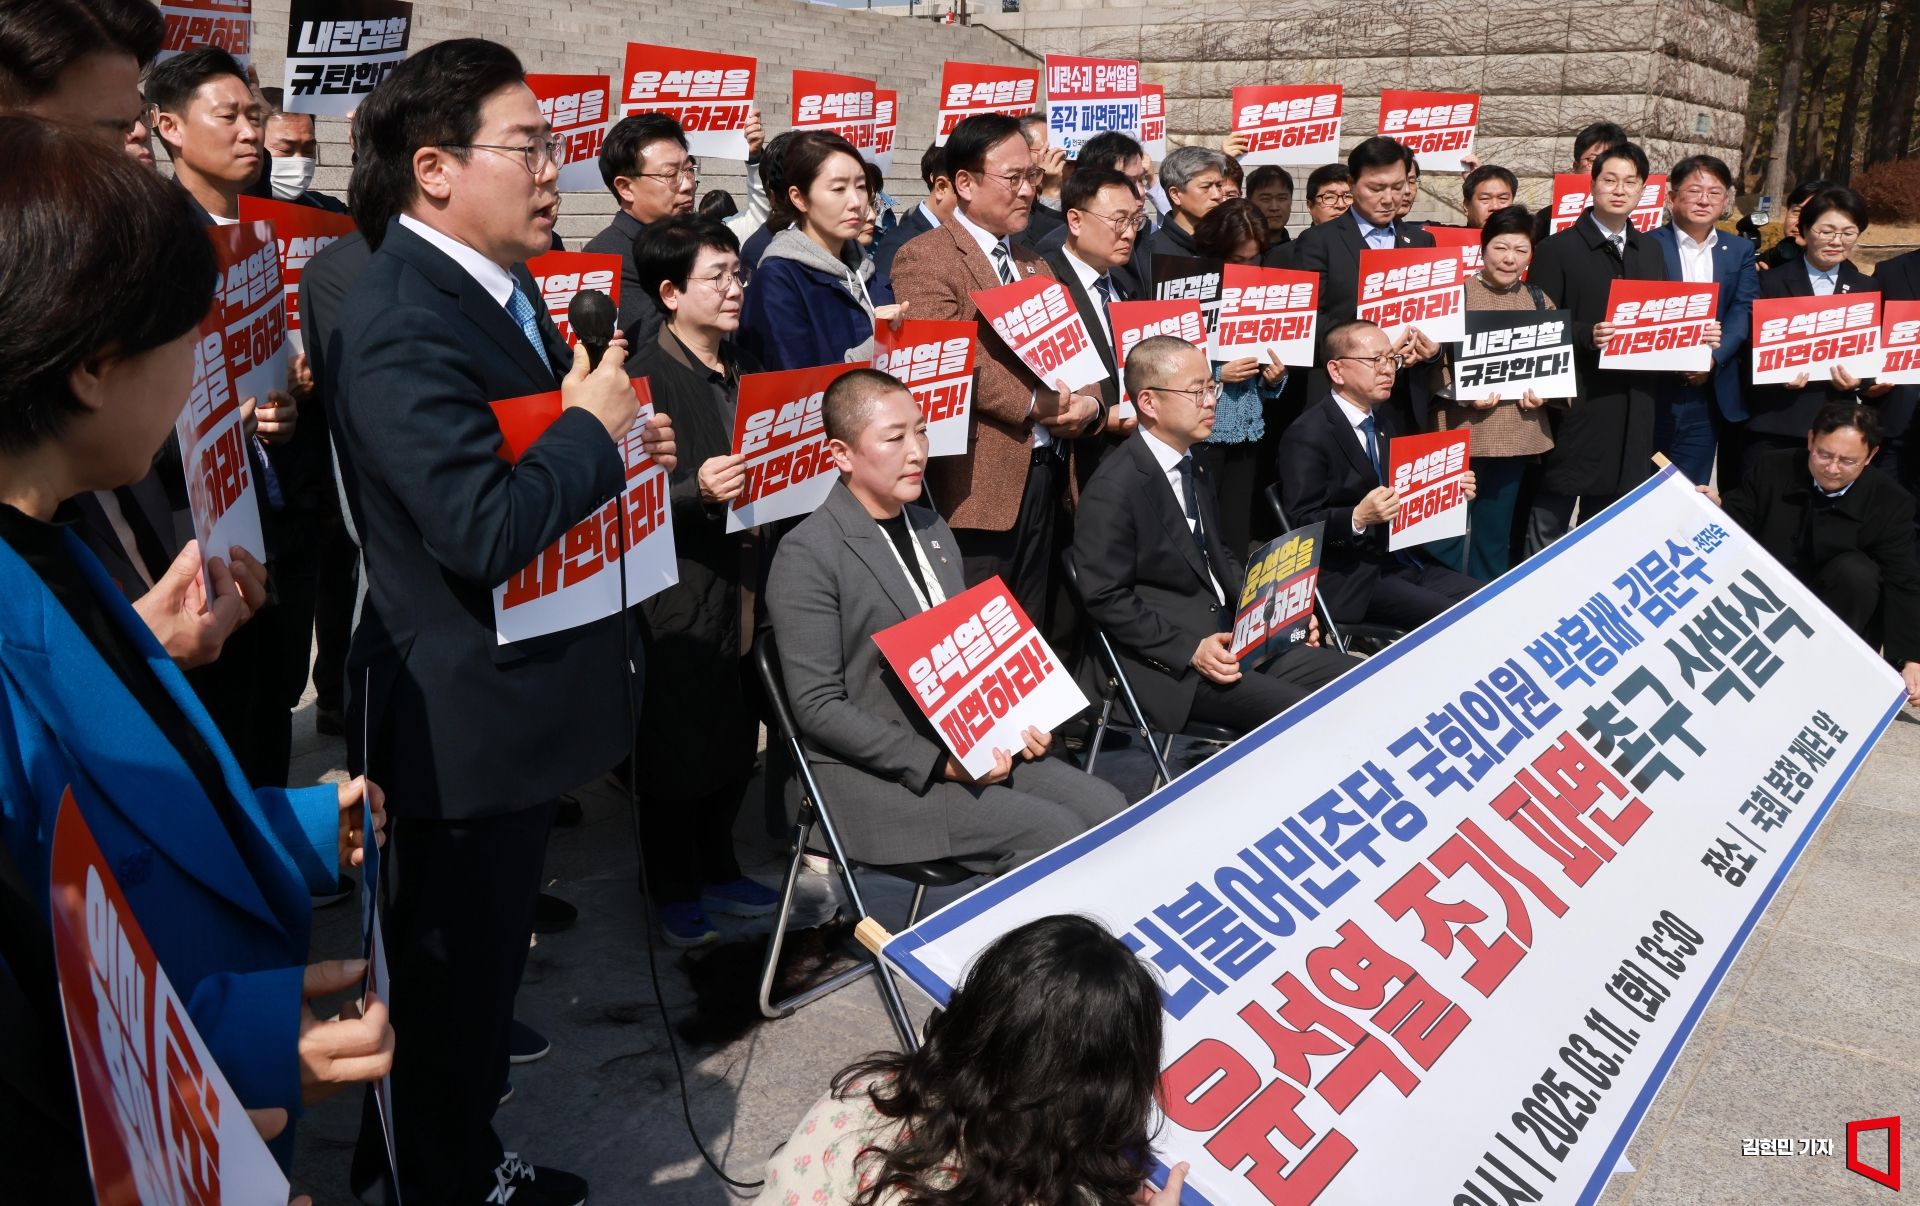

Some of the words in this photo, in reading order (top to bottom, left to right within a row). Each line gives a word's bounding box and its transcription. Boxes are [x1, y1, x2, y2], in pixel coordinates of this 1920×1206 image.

[297, 17, 406, 52] 내란검찰
[628, 69, 750, 99] 윤석열을
[946, 79, 1034, 107] 윤석열을
[1049, 65, 1092, 93] 내란수괴
[1096, 64, 1137, 93] 윤석열을
[798, 92, 873, 121] 윤석열을
[1051, 106, 1078, 133] 즉각
[1081, 104, 1138, 131] 파면하라!
[1238, 94, 1337, 128] 윤석열을
[1384, 103, 1474, 131] 윤석열을
[1396, 130, 1472, 154] 면하라!
[1221, 283, 1314, 314] 윤석열을
[1363, 258, 1458, 300] 윤석열을
[1611, 293, 1713, 326] 윤석열을
[1759, 302, 1875, 345] 윤석열을
[1461, 320, 1565, 358] 내란검찰
[1757, 330, 1877, 373] 파면하라!
[1460, 351, 1571, 388] 규탄한다!
[1394, 441, 1466, 494] 윤석열을
[1240, 535, 1315, 609] 윤석열을
[908, 594, 1022, 709] 윤석열을
[939, 635, 1054, 759] 파면하라!
[1386, 657, 1563, 798] 국회의원
[1822, 709, 1859, 744] 앞
[1787, 725, 1847, 774] 계단
[1763, 754, 1814, 804] 본청
[1738, 784, 1792, 832] 국회
[1700, 837, 1758, 887] 장소
[1153, 918, 1472, 1206] 윤석열
[1374, 817, 1570, 999] 조기
[1663, 568, 1815, 706] 삭발식
[1635, 909, 1704, 980] 13:30
[1604, 959, 1671, 1022] (화)
[1511, 1007, 1640, 1163] 2025.03.11.
